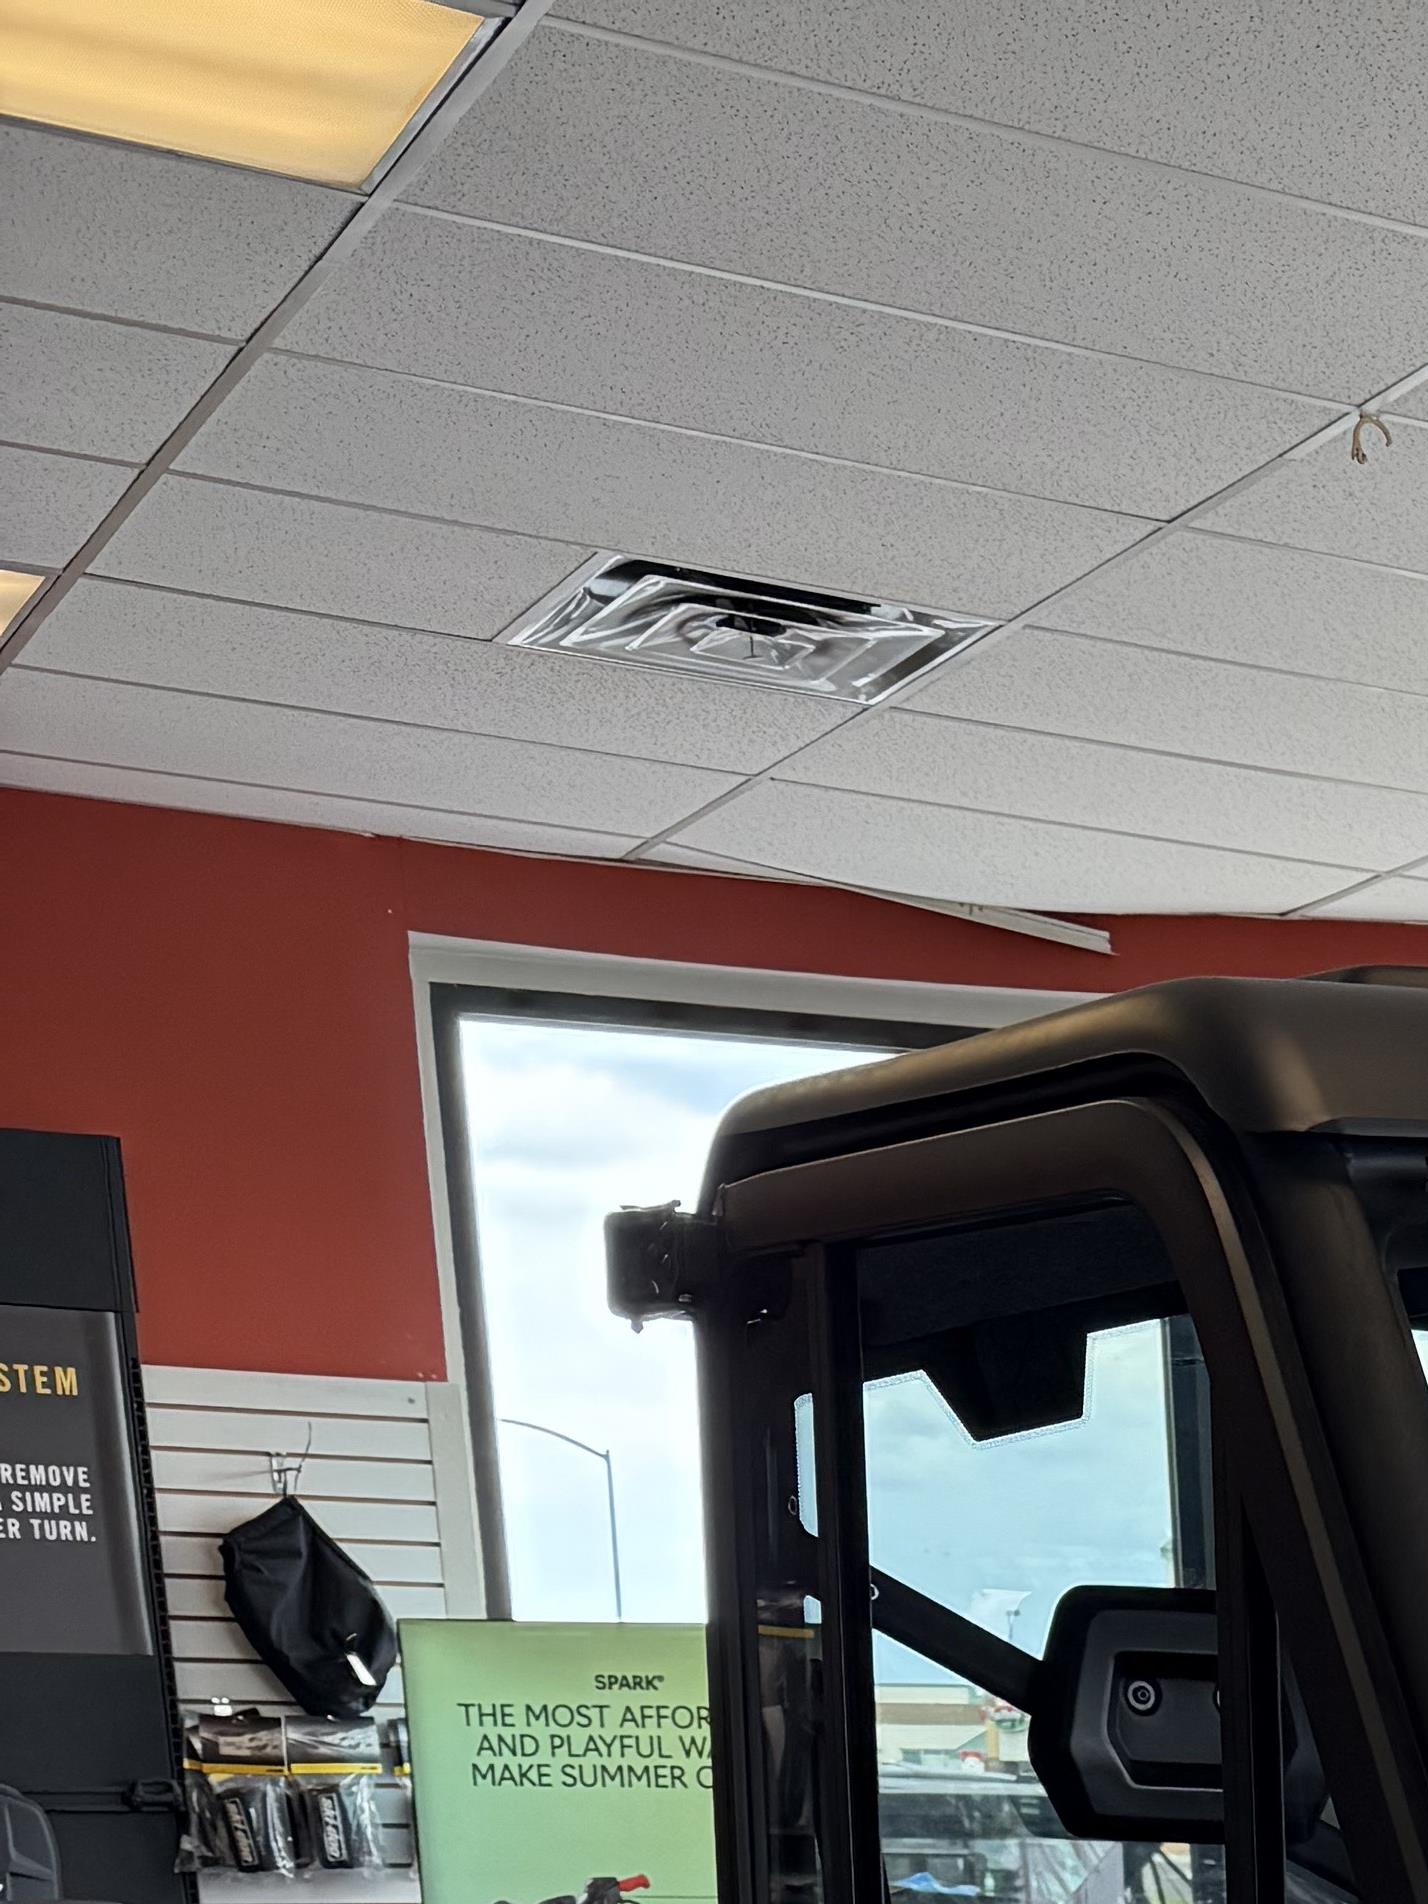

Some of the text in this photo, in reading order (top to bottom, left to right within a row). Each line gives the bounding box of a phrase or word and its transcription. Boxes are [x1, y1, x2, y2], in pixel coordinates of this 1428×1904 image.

[1, 1463, 91, 1488] REMOVE
[11, 1491, 94, 1515] SIMPLE
[30, 1518, 97, 1542] TURN.
[457, 1703, 516, 1728] THE
[525, 1704, 611, 1729] MOST
[476, 1734, 711, 1759] AND PLAYFUL W
[471, 1763, 553, 1788] MAKE
[560, 1764, 689, 1789] SUMMER
